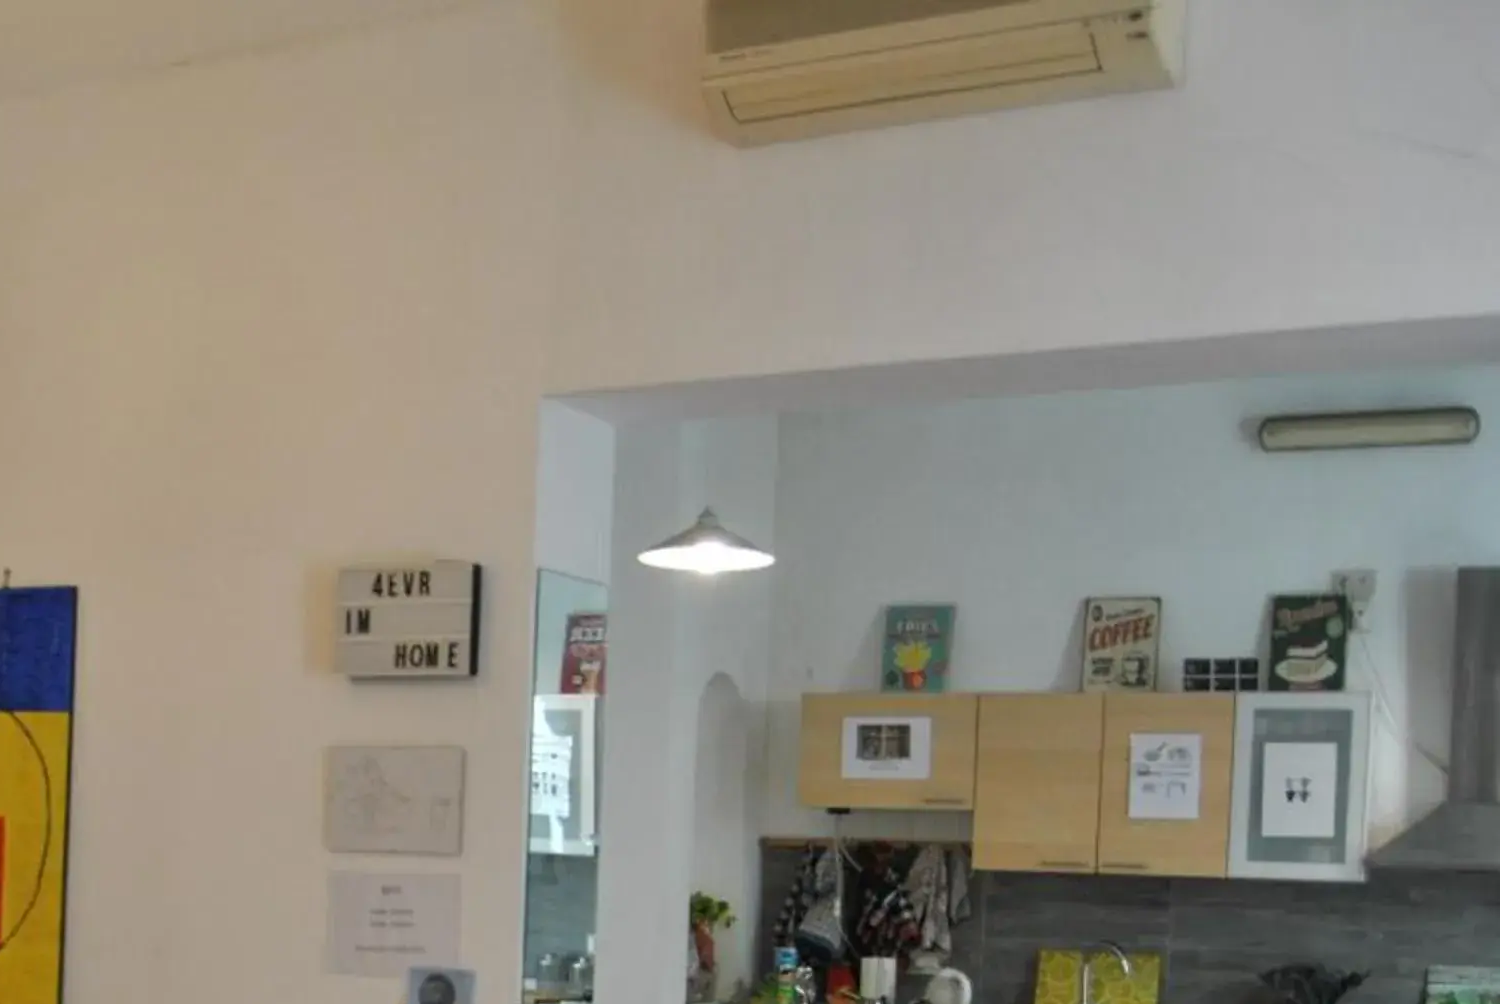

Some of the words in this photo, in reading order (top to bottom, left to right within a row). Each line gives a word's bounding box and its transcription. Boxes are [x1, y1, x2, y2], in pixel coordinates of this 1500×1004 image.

[371, 571, 432, 598] 4EVR
[344, 608, 372, 635] IM
[1088, 613, 1156, 652] COFFEE
[393, 642, 460, 669] HOME
